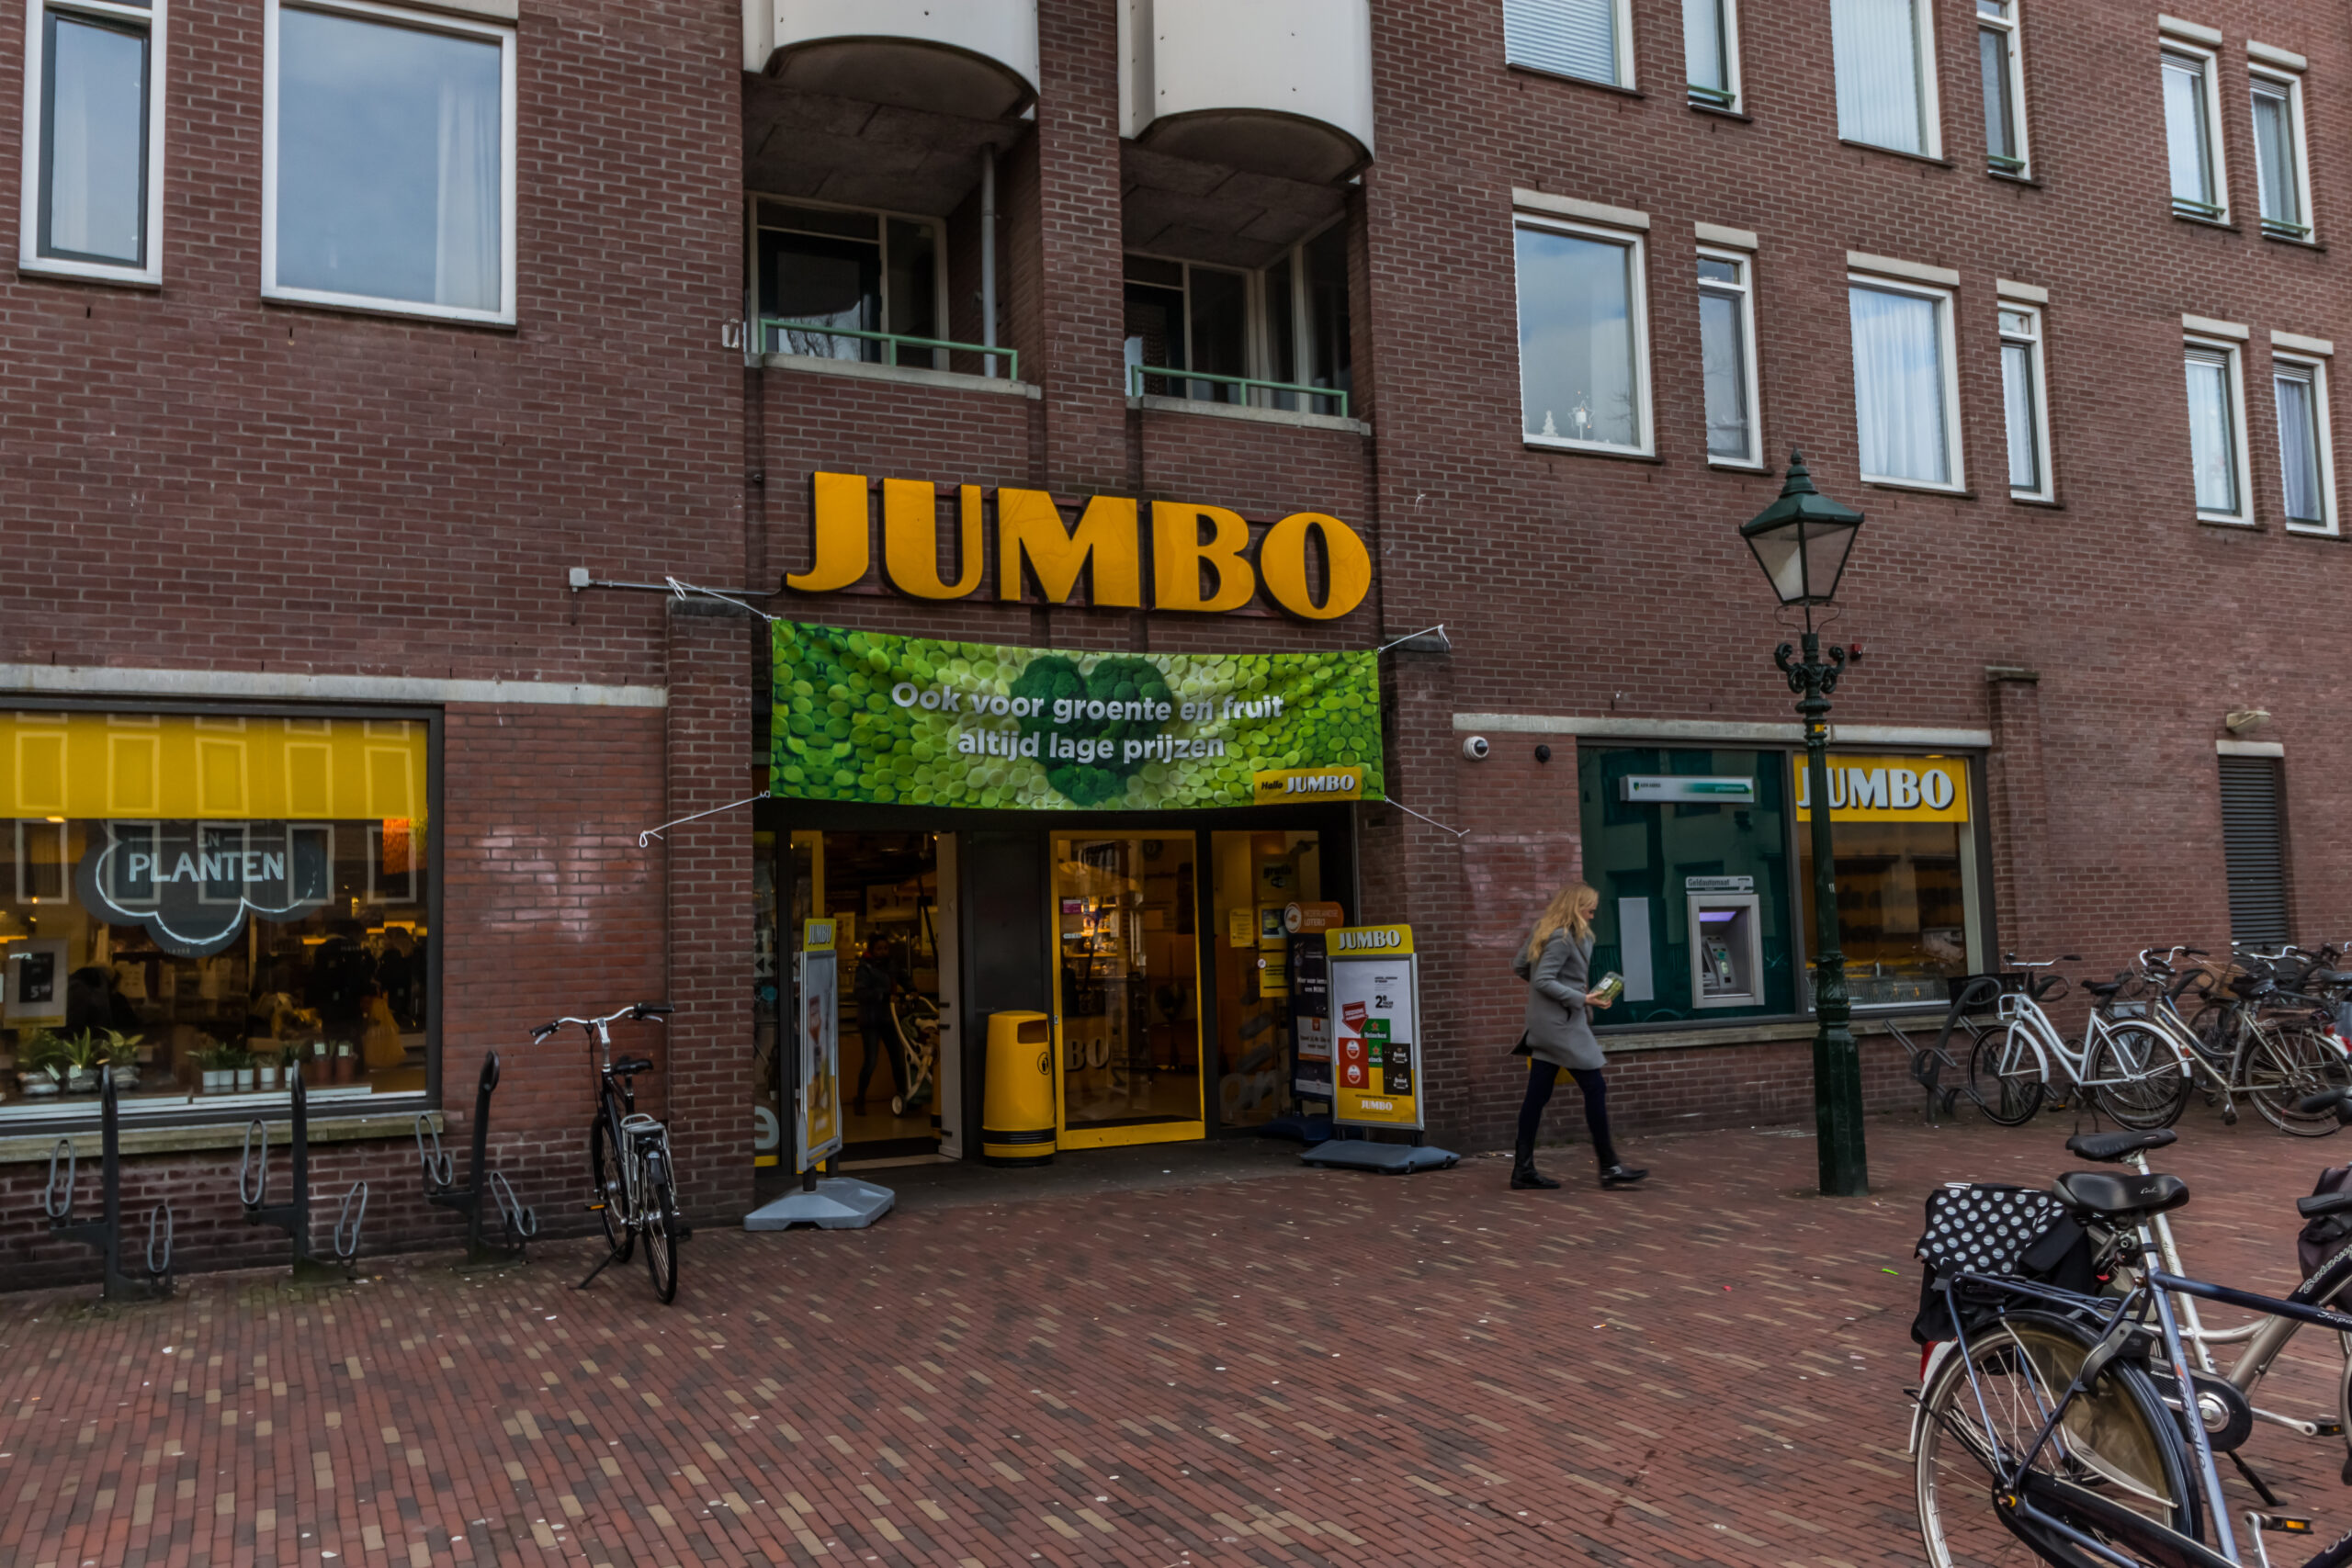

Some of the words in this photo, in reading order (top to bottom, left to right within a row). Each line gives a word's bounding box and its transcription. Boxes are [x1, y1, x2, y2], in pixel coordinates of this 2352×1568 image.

[786, 471, 1373, 621] JUMBO
[891, 682, 961, 713] Ook
[970, 693, 1045, 719] voor
[1053, 696, 1171, 727] groente
[1180, 701, 1214, 721] en
[1223, 695, 1283, 721] fruit
[958, 728, 1040, 762] altijd
[1049, 731, 1114, 765] lage
[1123, 734, 1225, 764] prijzen
[1261, 780, 1283, 791] Hallo
[1285, 774, 1355, 795] JUMBO
[1796, 767, 1954, 810] JUMBO
[198, 830, 220, 849] EN
[129, 851, 285, 883] PLANTEN
[1687, 877, 1730, 887] Geldautomaat
[808, 923, 832, 945] JUMBO
[1338, 929, 1401, 950] JUMBO
[1361, 1099, 1394, 1111] JUMBO
[2177, 1378, 2207, 1470] Gazelle
